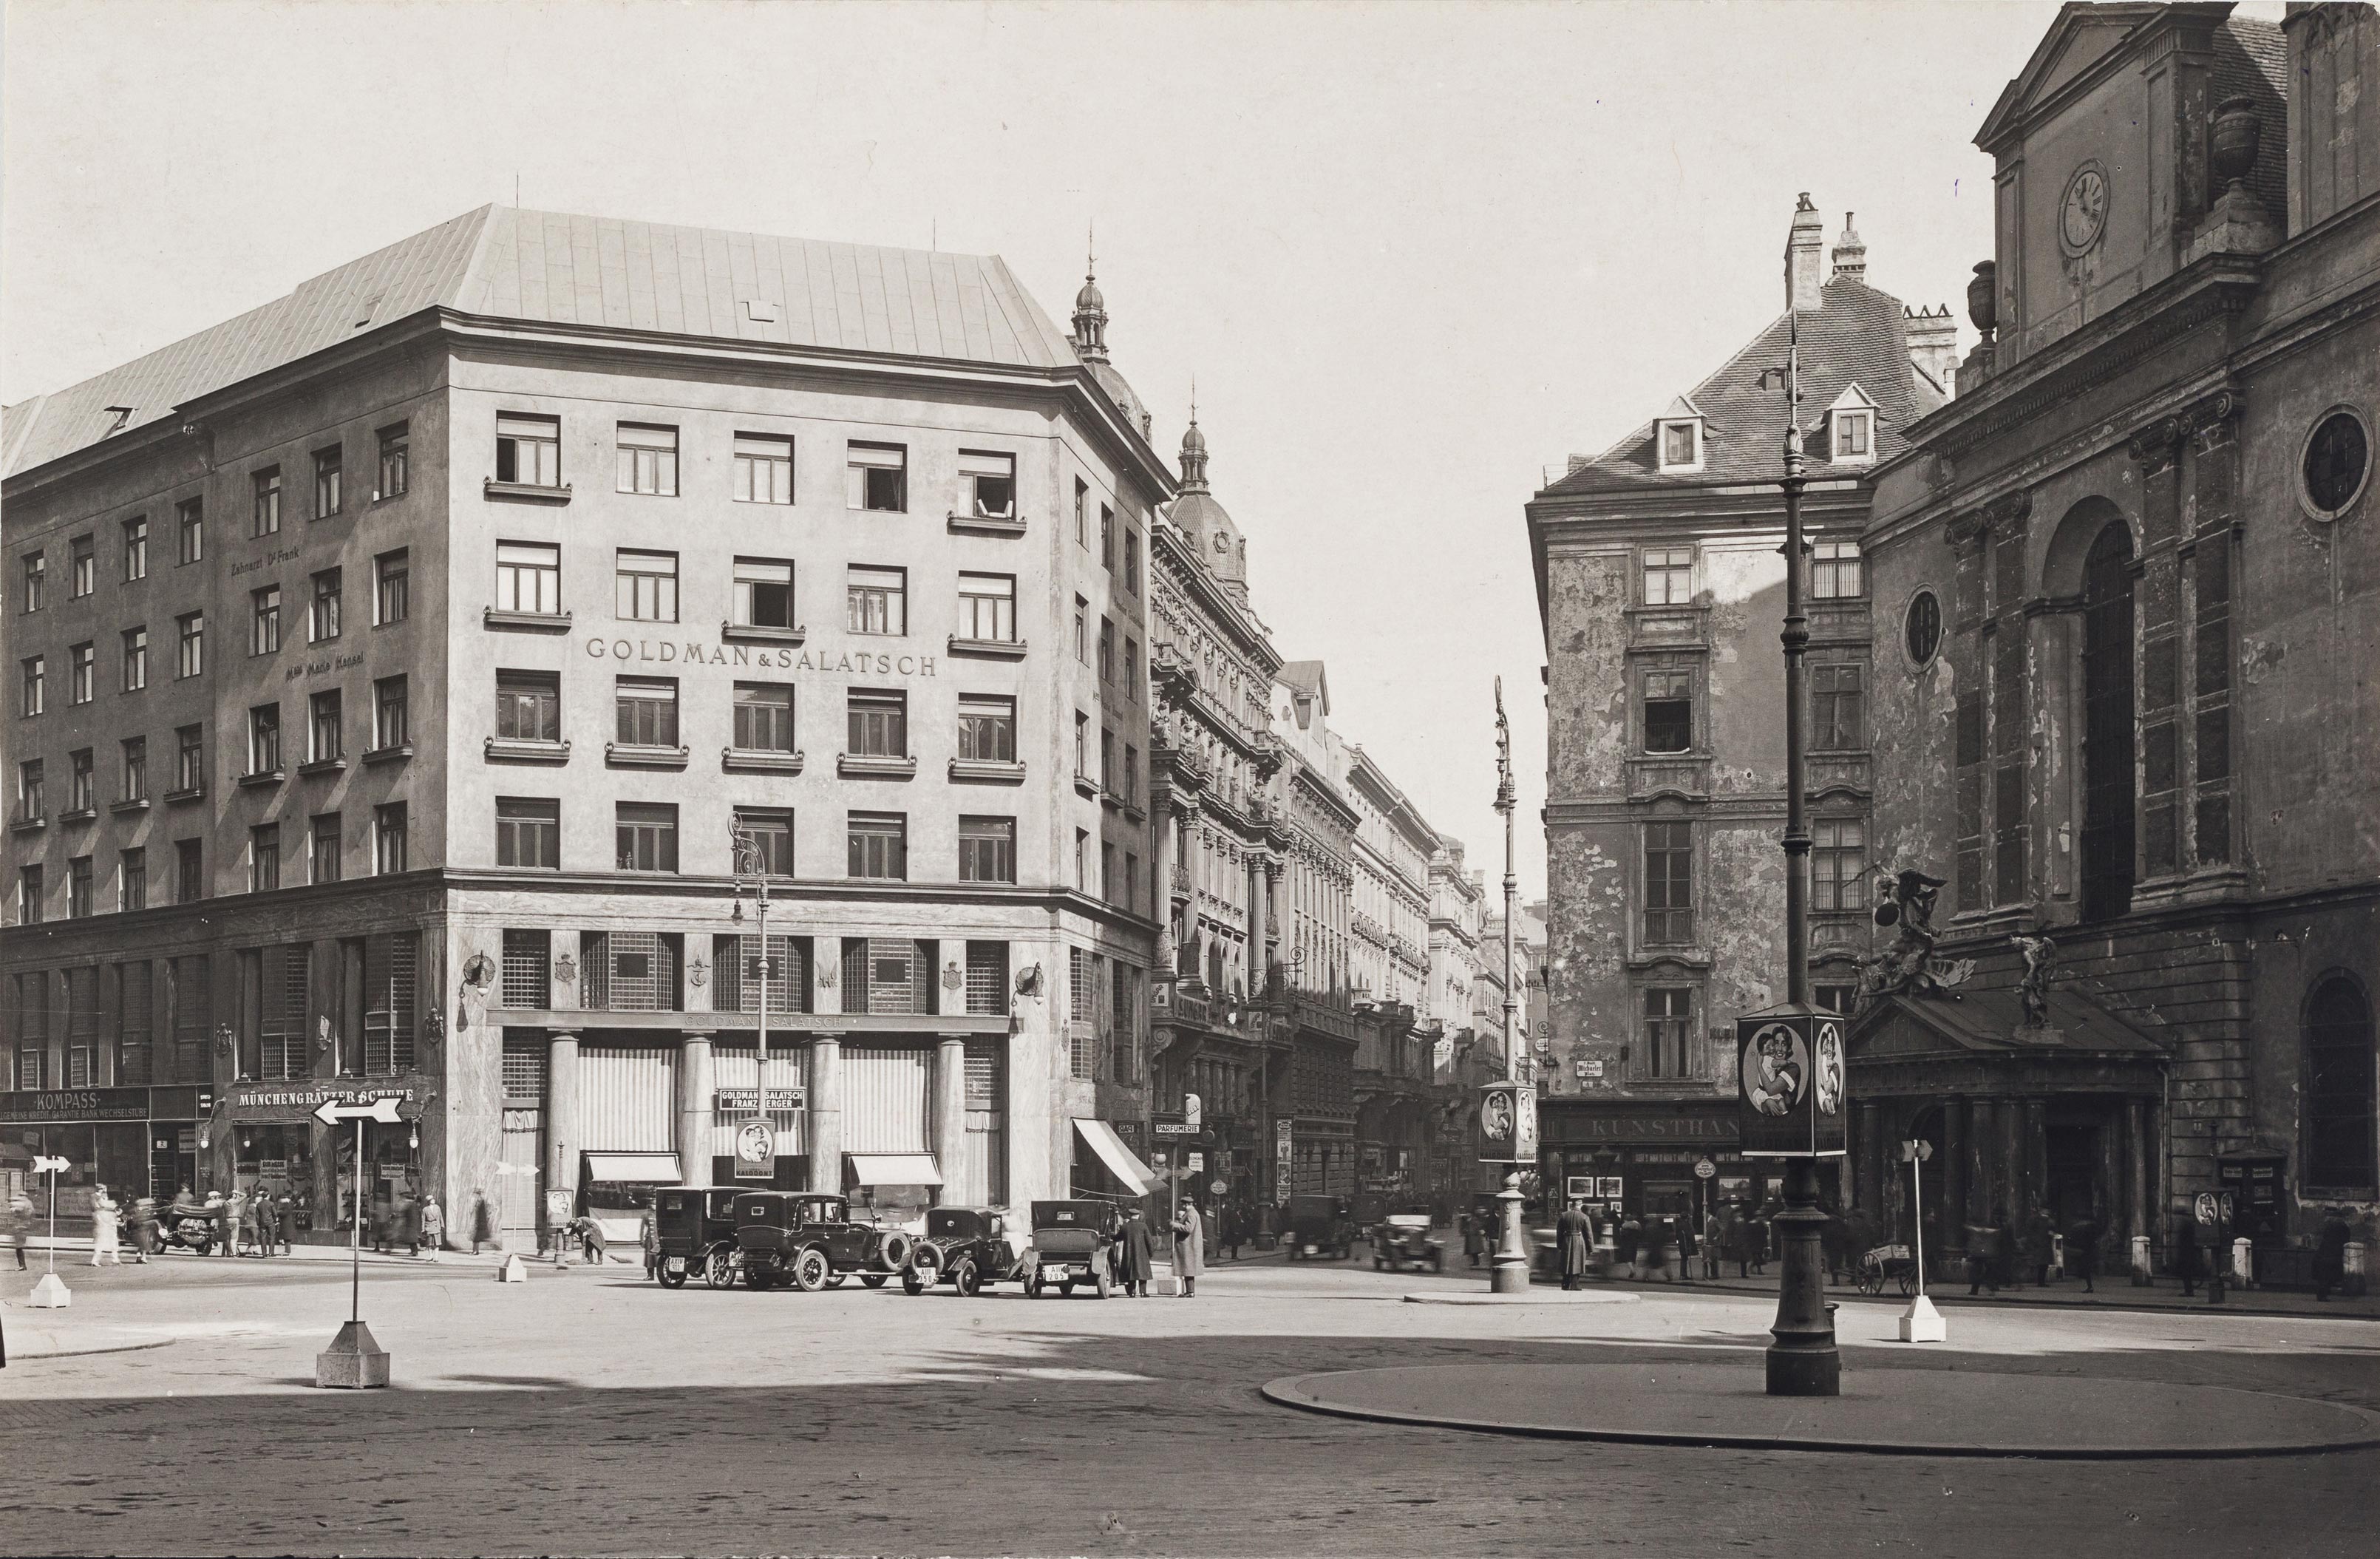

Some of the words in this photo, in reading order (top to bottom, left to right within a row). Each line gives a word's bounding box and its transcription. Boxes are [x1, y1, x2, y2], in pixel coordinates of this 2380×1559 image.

[231, 557, 262, 576] Zahnarzt
[277, 546, 299, 563] Frank
[586, 638, 749, 665] GOLDMAN
[758, 653, 772, 667] &
[778, 649, 936, 676] SALATSCH
[307, 662, 331, 676] Marie
[684, 1016, 755, 1027] GOLDMAN
[772, 1017, 842, 1028] SALATSCH
[722, 1091, 758, 1099] GOLDMAN
[765, 1091, 802, 1100] SALATSCH
[732, 1099, 758, 1107] FRANZ
[99, 1108, 148, 1118] WECHSELSTUBE
